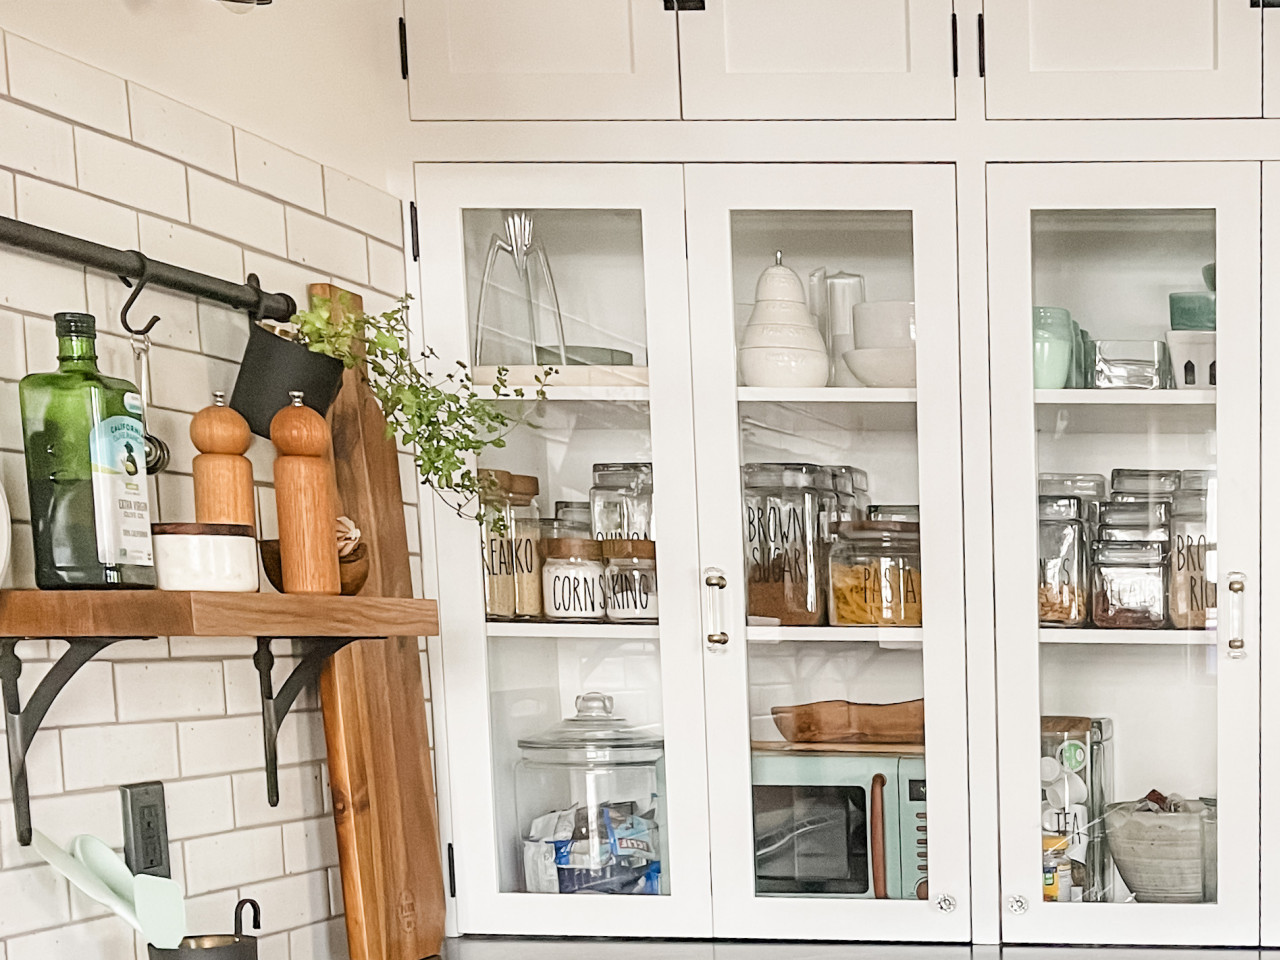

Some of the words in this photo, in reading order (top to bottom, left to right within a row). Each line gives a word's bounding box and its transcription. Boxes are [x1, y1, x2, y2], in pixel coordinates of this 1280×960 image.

[748, 506, 805, 544] BROWN
[753, 547, 804, 584] SUGAR
[864, 567, 917, 604] PASTA
[1054, 812, 1081, 845] TEA
